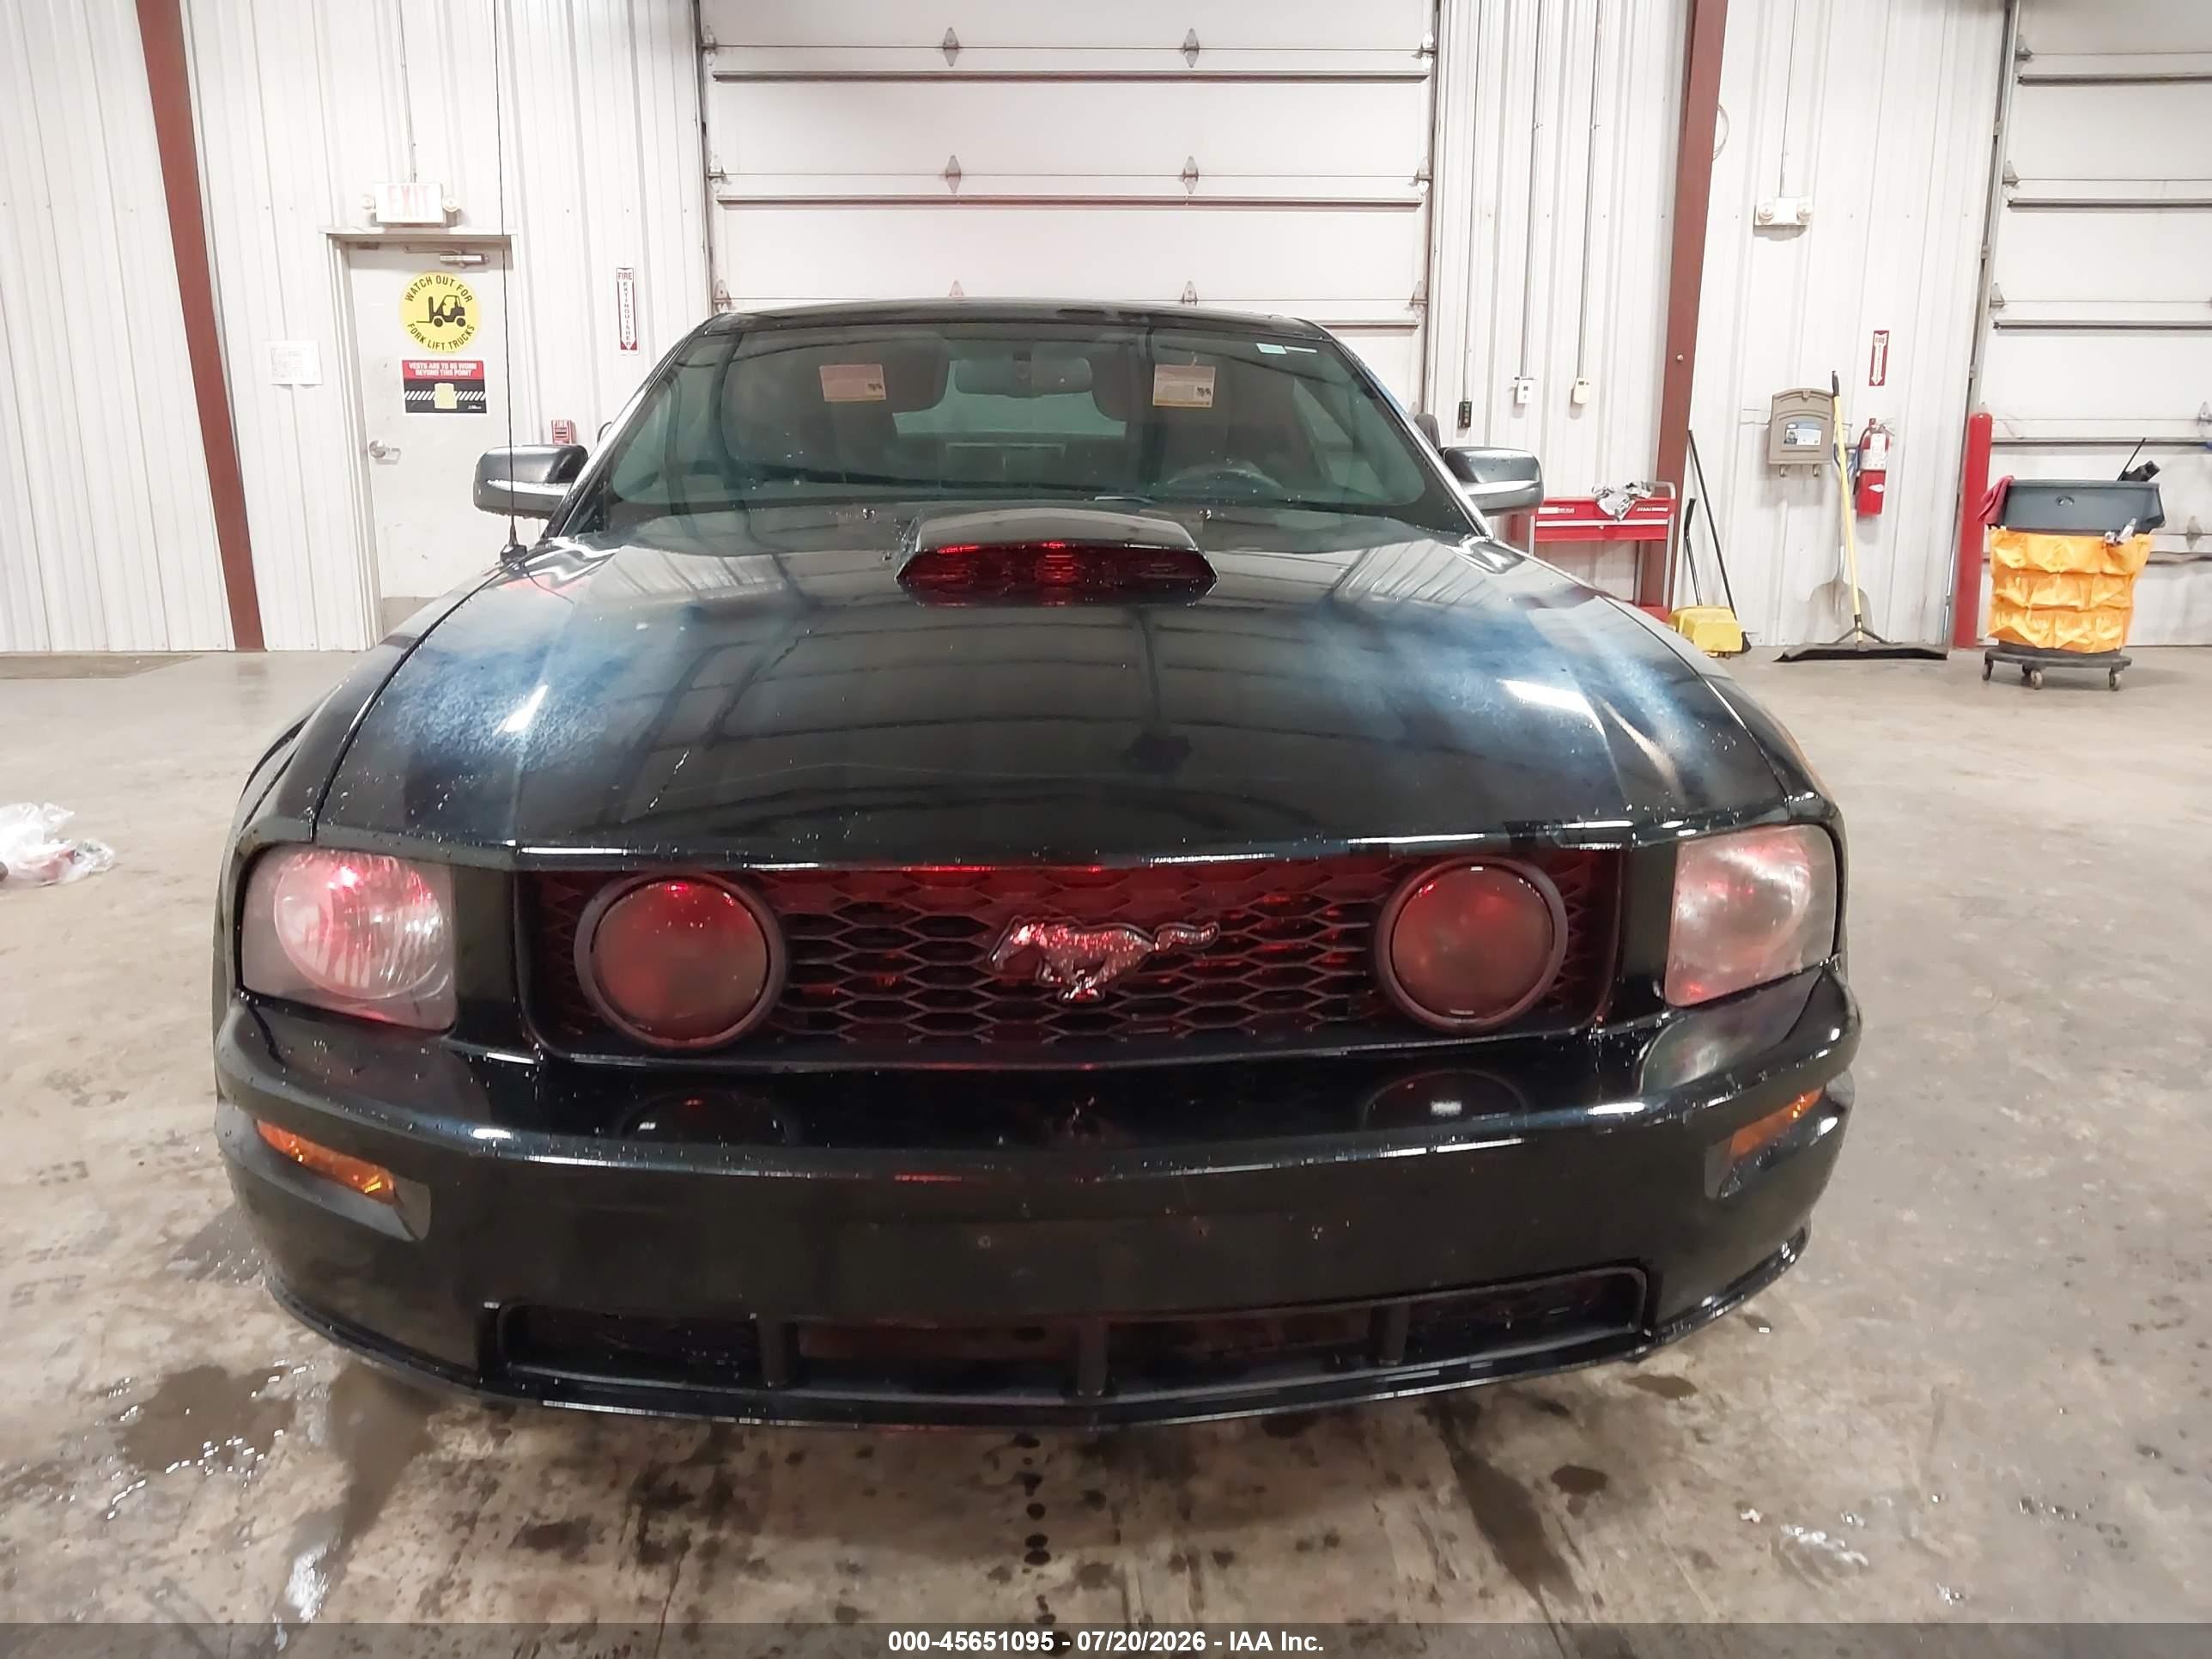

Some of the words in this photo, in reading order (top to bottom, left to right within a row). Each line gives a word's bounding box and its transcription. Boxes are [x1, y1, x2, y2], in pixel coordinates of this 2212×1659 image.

[387, 185, 430, 218] EXIT
[405, 276, 433, 302] WATCH
[435, 275, 456, 287] OUT
[456, 283, 473, 302] FOR
[617, 272, 632, 281] FIRE
[623, 281, 631, 346] EXTINGUISHER
[407, 323, 426, 344] FORK
[427, 339, 445, 350] LIFT
[447, 324, 475, 349] TRUCKS
